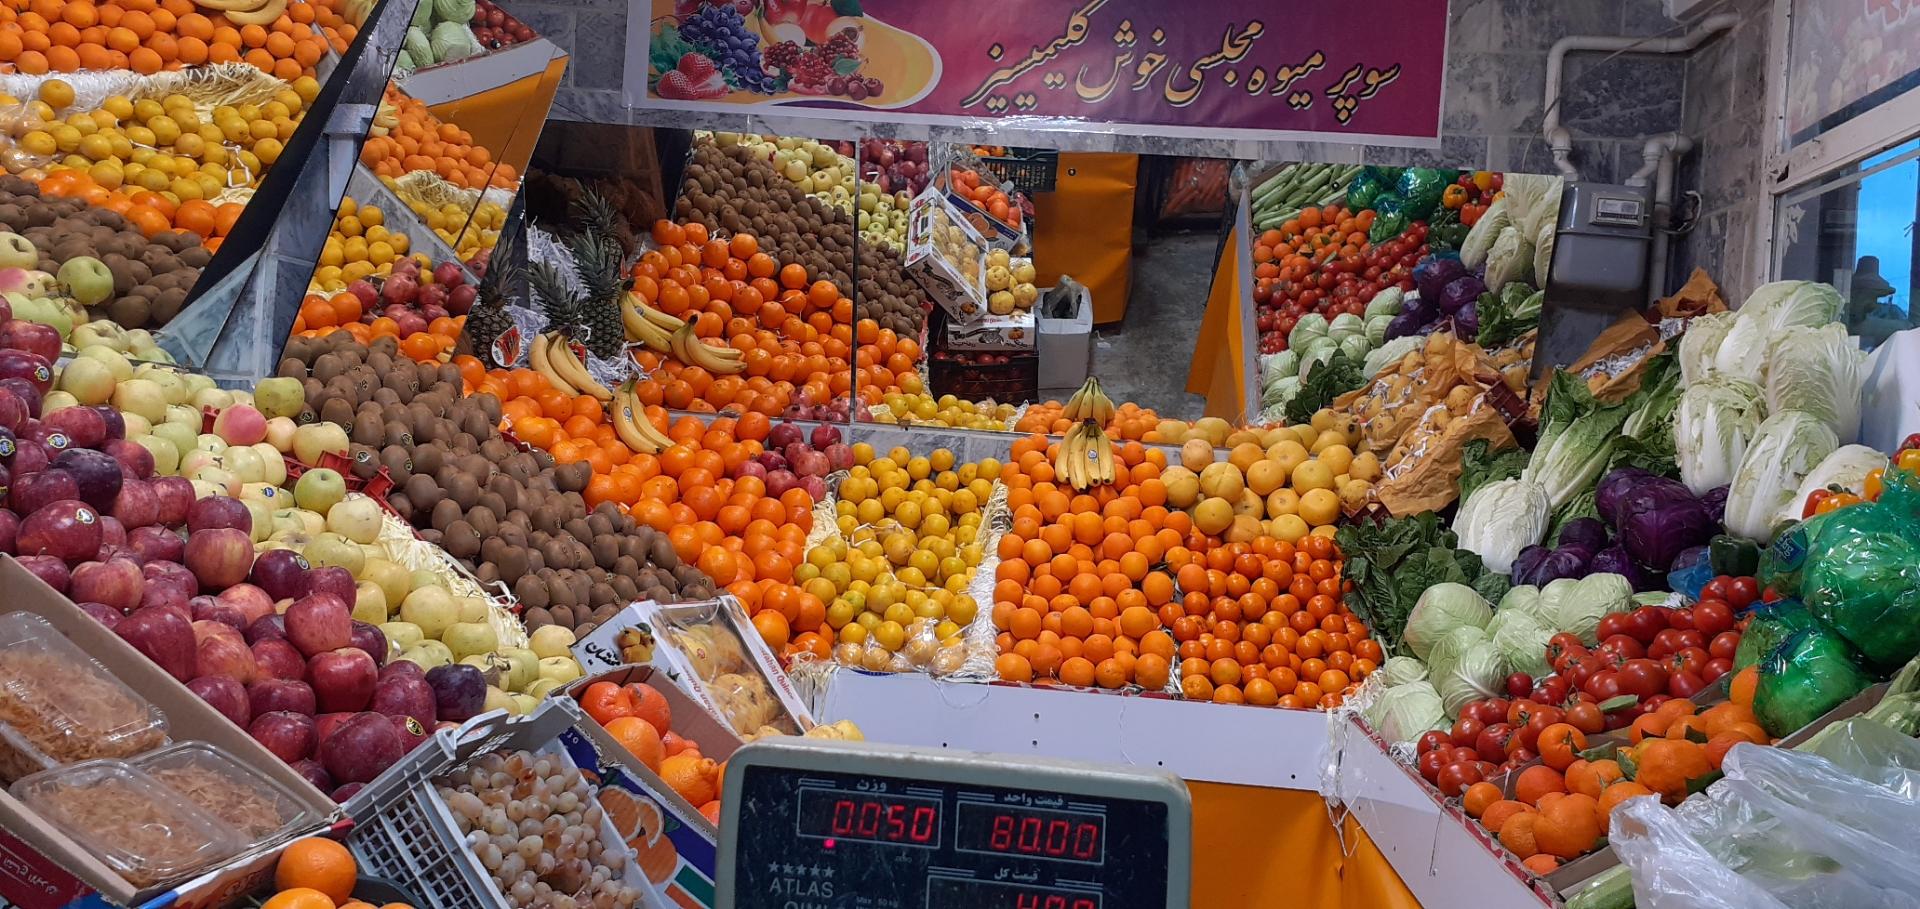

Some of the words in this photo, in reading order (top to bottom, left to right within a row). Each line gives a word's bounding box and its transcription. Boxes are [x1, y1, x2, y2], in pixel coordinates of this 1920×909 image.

[1075, 19, 1168, 103] خوش
[1164, 20, 1264, 107] مجلسی
[1247, 51, 1326, 110] میوه
[1325, 62, 1401, 126] سوپر
[856, 779, 887, 792] وزن
[1004, 793, 1033, 807] واحد
[1034, 794, 1064, 808] قیمت
[991, 816, 1098, 859] 80.00
[994, 867, 1010, 880] کل
[1012, 868, 1039, 881] قیمت
[769, 877, 834, 898] ATLAS
